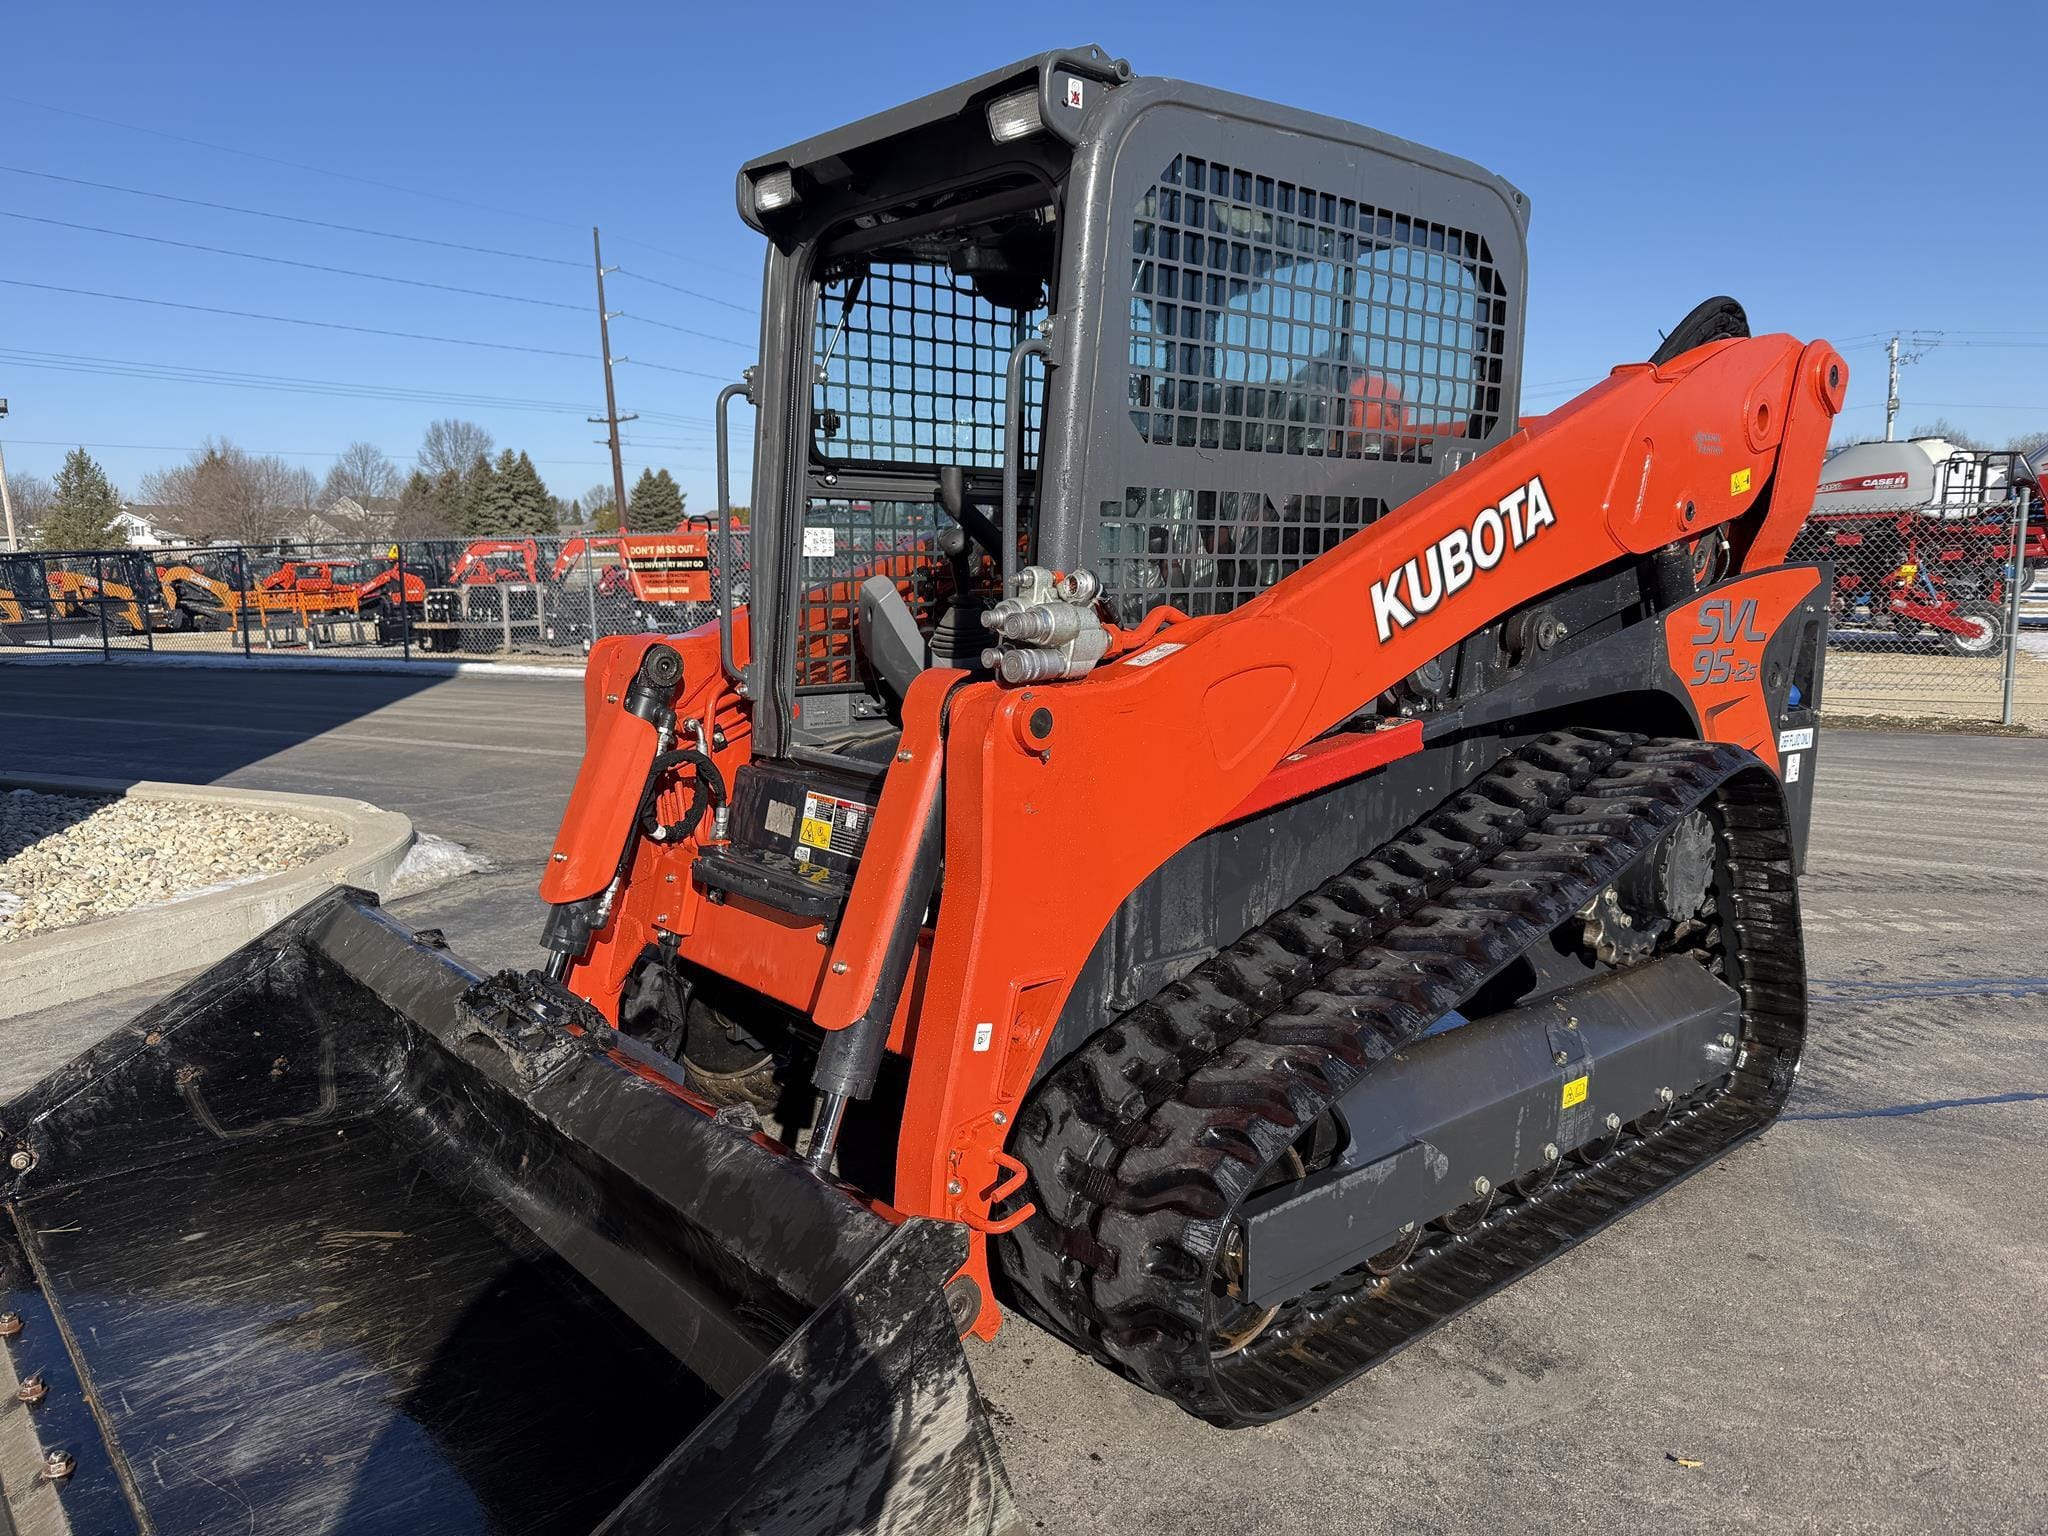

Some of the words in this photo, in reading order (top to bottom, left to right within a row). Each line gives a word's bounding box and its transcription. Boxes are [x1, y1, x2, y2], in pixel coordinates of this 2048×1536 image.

[1862, 478, 1892, 487] CASE
[629, 545, 655, 555] DON'T
[656, 544, 676, 554] MSS
[677, 544, 695, 554] OUT
[644, 560, 676, 569] INVENTRY
[676, 560, 693, 568] MUST
[693, 560, 704, 568] GO
[1370, 475, 1556, 643] KUBOTA
[1692, 599, 1766, 645] SVL
